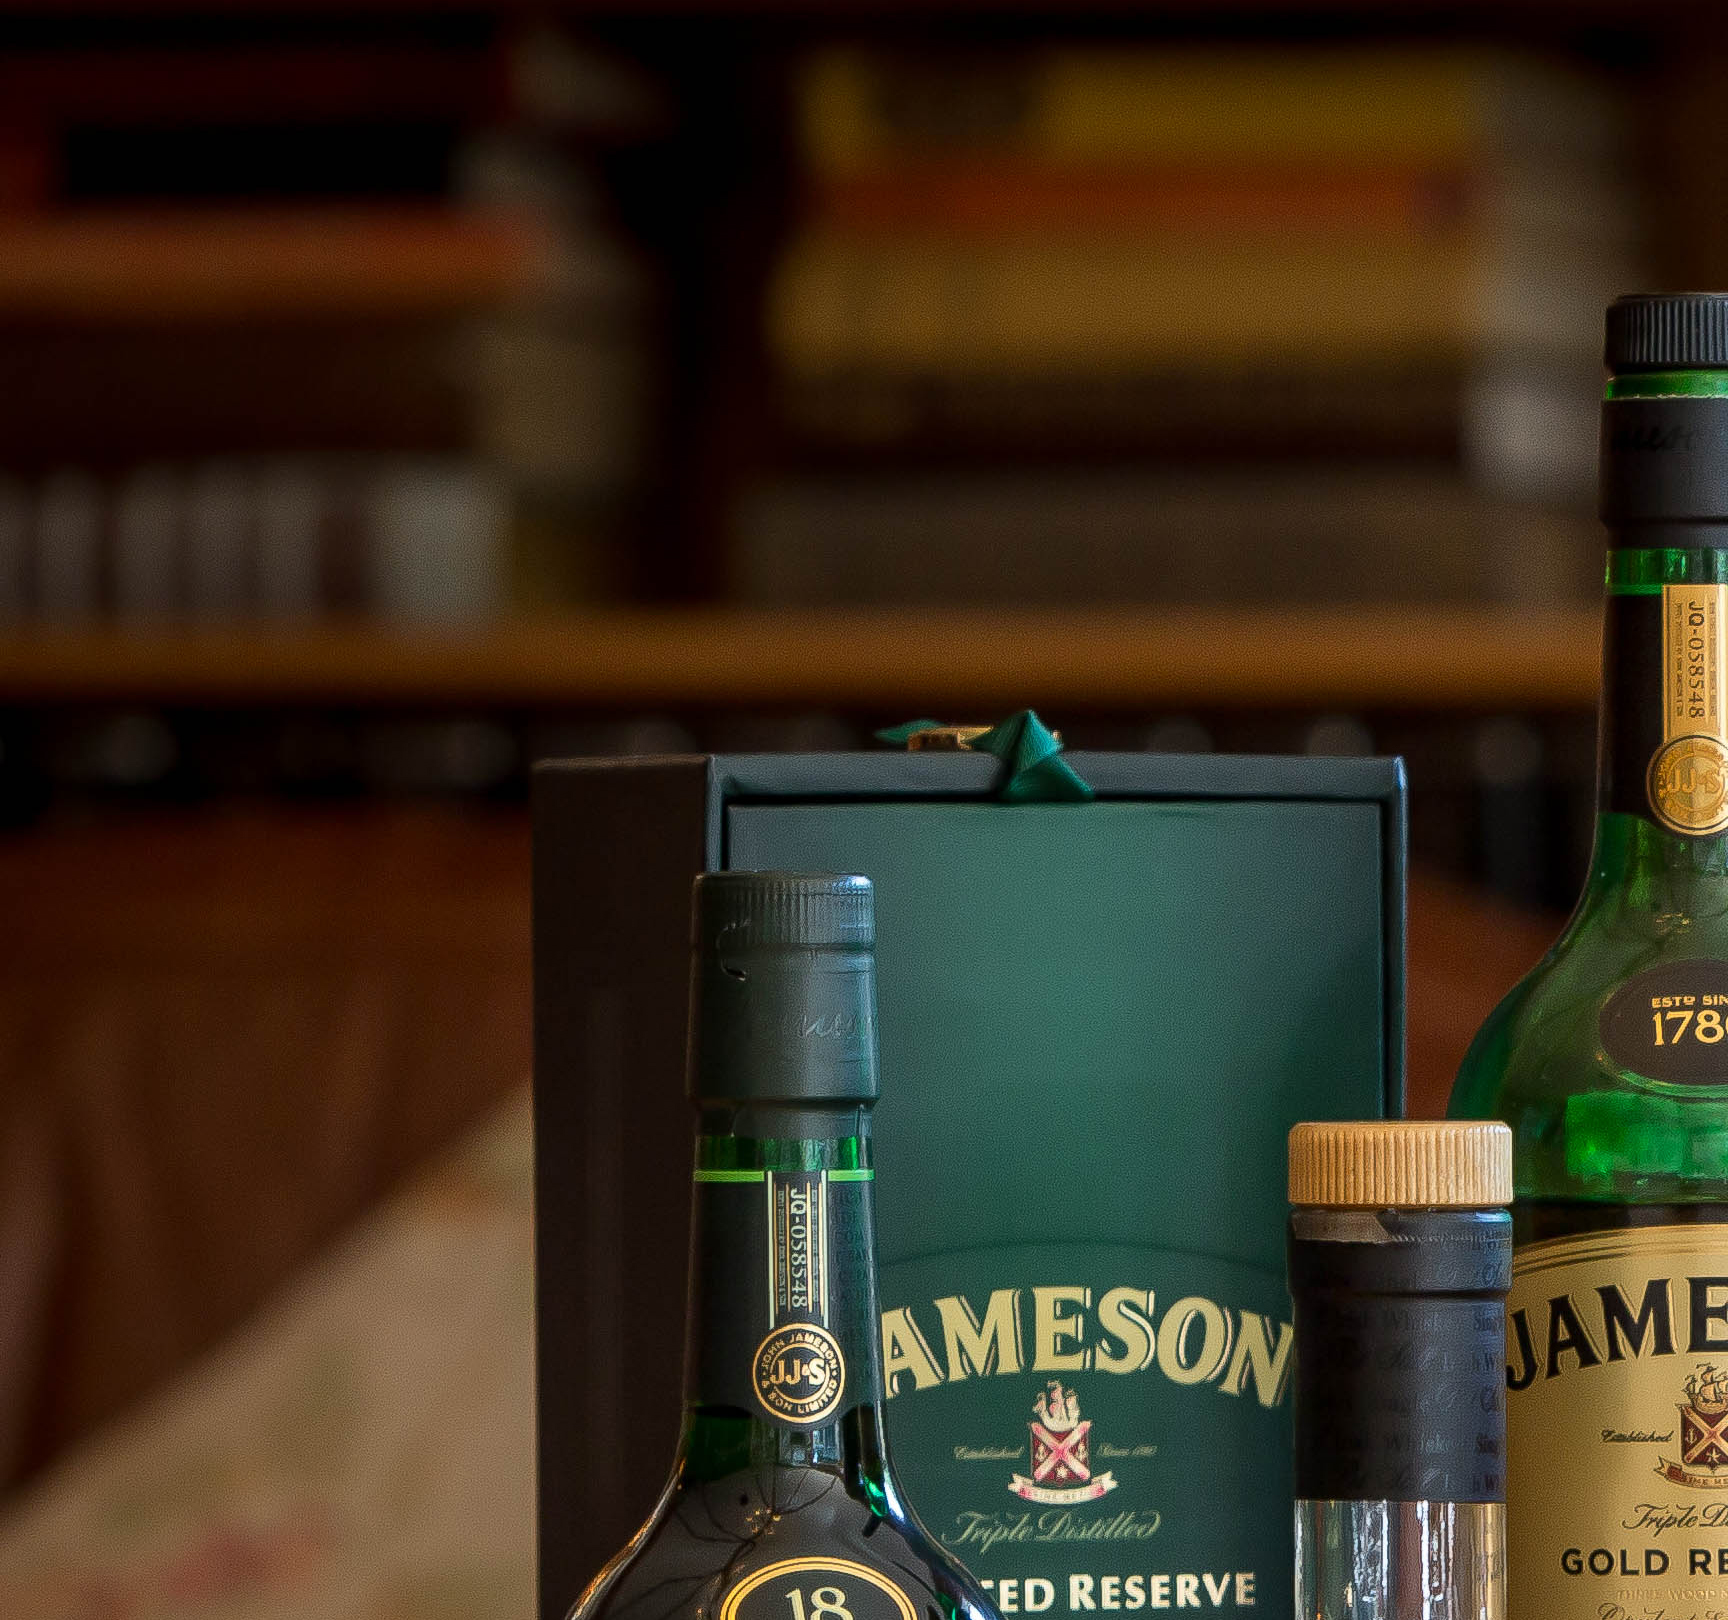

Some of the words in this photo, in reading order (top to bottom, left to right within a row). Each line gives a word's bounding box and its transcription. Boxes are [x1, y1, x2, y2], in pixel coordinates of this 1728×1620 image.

[1688, 602, 1704, 719] JQ-058548
[791, 1188, 807, 1308] JQ-058548
[882, 1286, 1294, 1407] AMESON
[1623, 1504, 1698, 1536] Triple
[1069, 1573, 1256, 1612] RESERVE
[1561, 1547, 1669, 1577] GOLD
